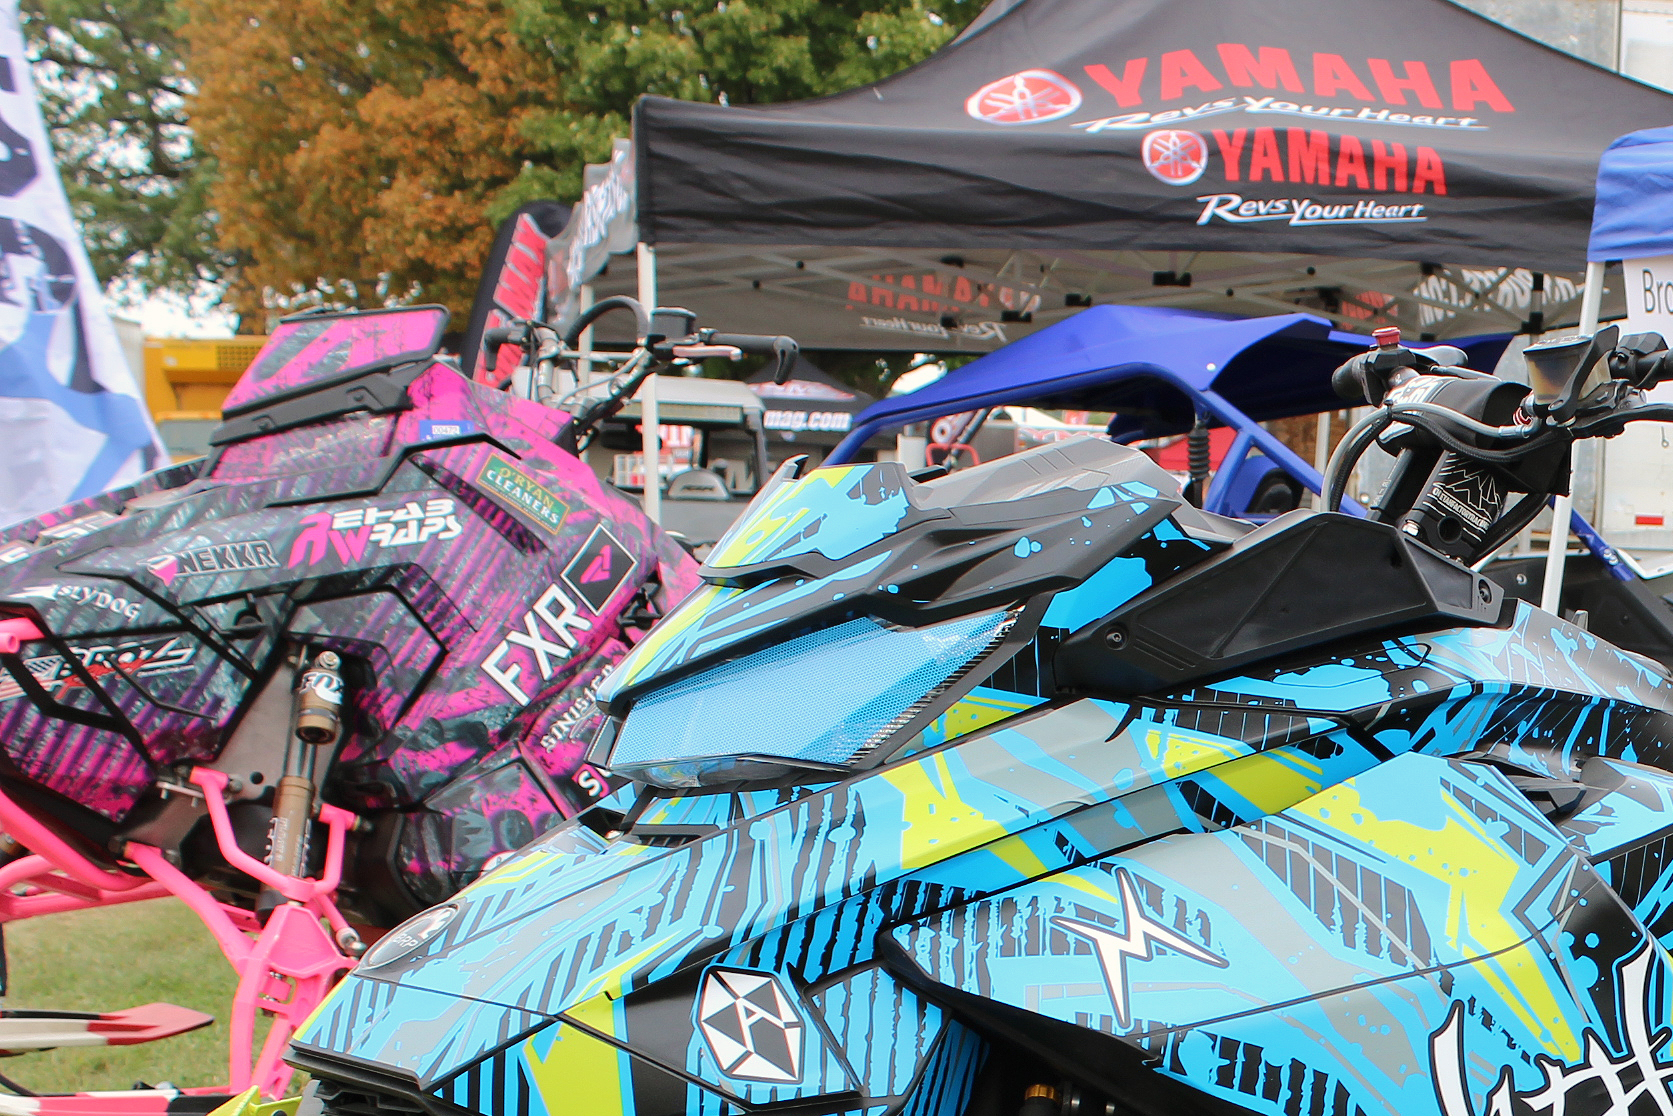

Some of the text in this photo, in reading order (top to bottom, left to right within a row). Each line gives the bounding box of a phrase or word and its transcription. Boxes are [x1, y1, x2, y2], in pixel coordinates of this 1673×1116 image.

[1084, 42, 1516, 113] YAMAHA
[1071, 96, 1490, 134] Revs Your Heart
[1213, 126, 1448, 195] YAMAHA
[1196, 193, 1428, 226] Revs Your Heart
[485, 469, 560, 525] CLEANERS
[498, 466, 557, 509] O'RYAN
[175, 539, 281, 577] NEKKR
[480, 582, 593, 707] FXR
